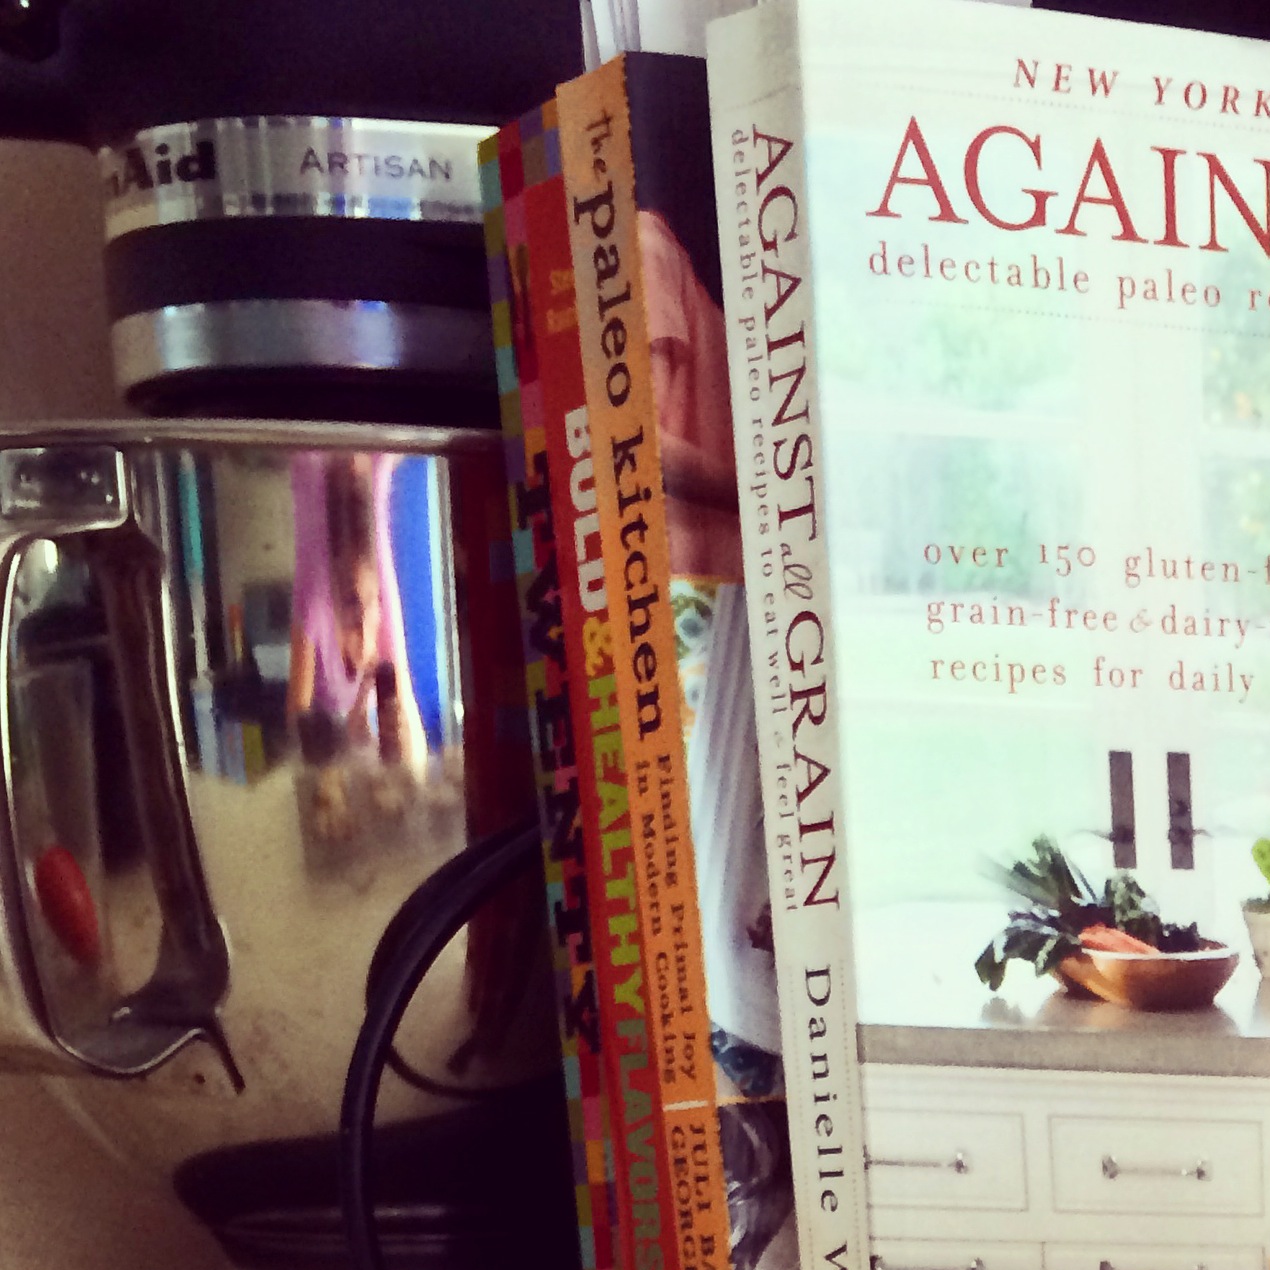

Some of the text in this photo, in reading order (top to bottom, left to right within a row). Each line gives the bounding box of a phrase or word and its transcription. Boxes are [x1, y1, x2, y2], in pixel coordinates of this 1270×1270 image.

[1013, 58, 1120, 98] NEW
[300, 146, 452, 182] ARTISAN
[584, 107, 616, 179] the
[731, 129, 760, 301] delectable
[869, 241, 1090, 294] delectable
[1117, 269, 1221, 309] paleo
[738, 316, 761, 402] paleo
[573, 184, 663, 742] paleo kitchen
[750, 416, 769, 535] recipes
[565, 408, 607, 612] BOLD
[752, 124, 840, 911] AGAINST all GRAIN
[760, 550, 773, 577] to
[923, 543, 1009, 568] over
[1038, 543, 1096, 577] 150
[582, 617, 614, 677] &
[764, 593, 779, 637] eat
[926, 596, 1118, 634] grain-free
[1129, 608, 1153, 634] &
[768, 652, 788, 714] well
[930, 653, 1067, 694] recipes
[1093, 656, 1144, 688] for
[1168, 660, 1254, 704] daily
[516, 450, 600, 1054] TWENTY
[777, 764, 794, 820] feel
[588, 674, 645, 1012] HEALTHY
[776, 833, 800, 912] great
[635, 760, 677, 1085] in Modern Cooking
[656, 754, 697, 1080] Finding Primal Joy
[804, 964, 845, 1213] Danielle
[689, 1124, 712, 1213] JULI
